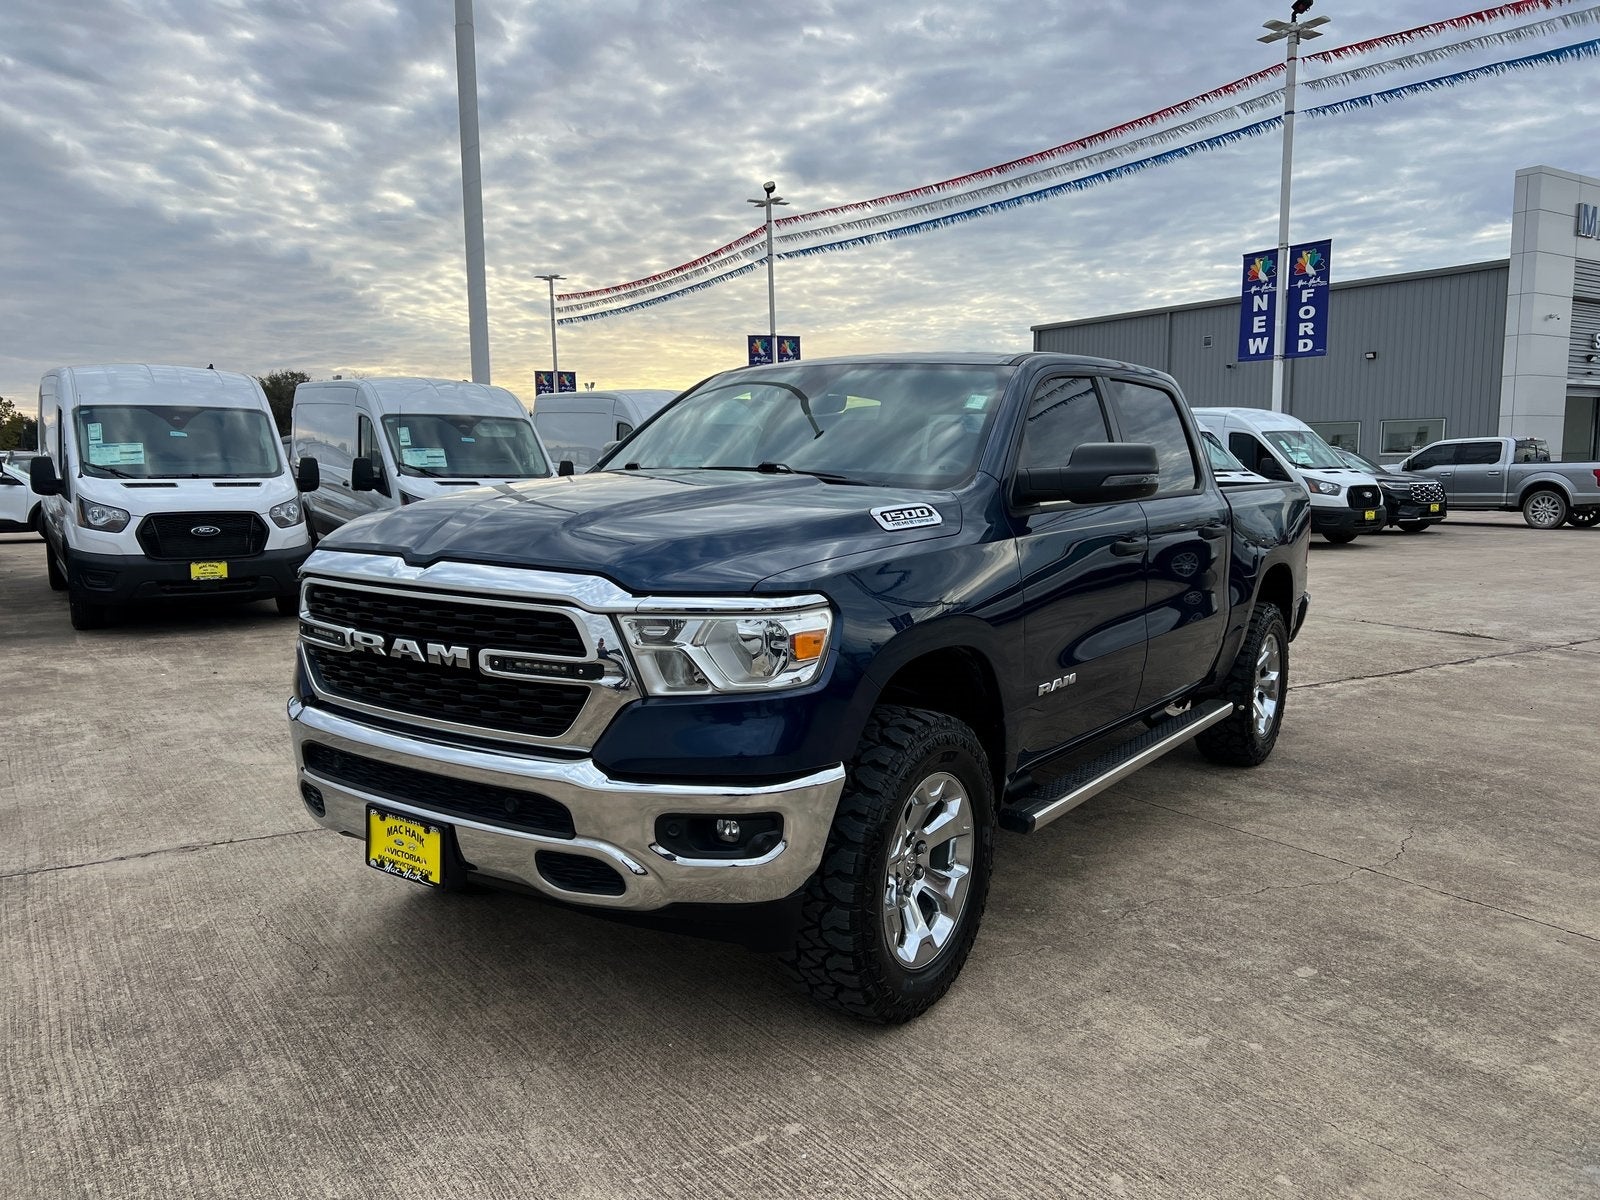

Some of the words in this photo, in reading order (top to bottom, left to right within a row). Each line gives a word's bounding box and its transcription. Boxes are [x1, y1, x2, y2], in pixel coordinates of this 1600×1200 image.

[1248, 294, 1269, 355] NEW
[1298, 289, 1316, 353] FORD
[882, 508, 929, 521] 1500
[354, 630, 470, 669] RAM
[1038, 672, 1077, 697] RAM
[386, 825, 403, 837] MAC
[405, 826, 424, 848] HAIK
[390, 847, 422, 864] VICTORIA
[383, 862, 402, 876] Mac
[402, 868, 425, 882] Haik
